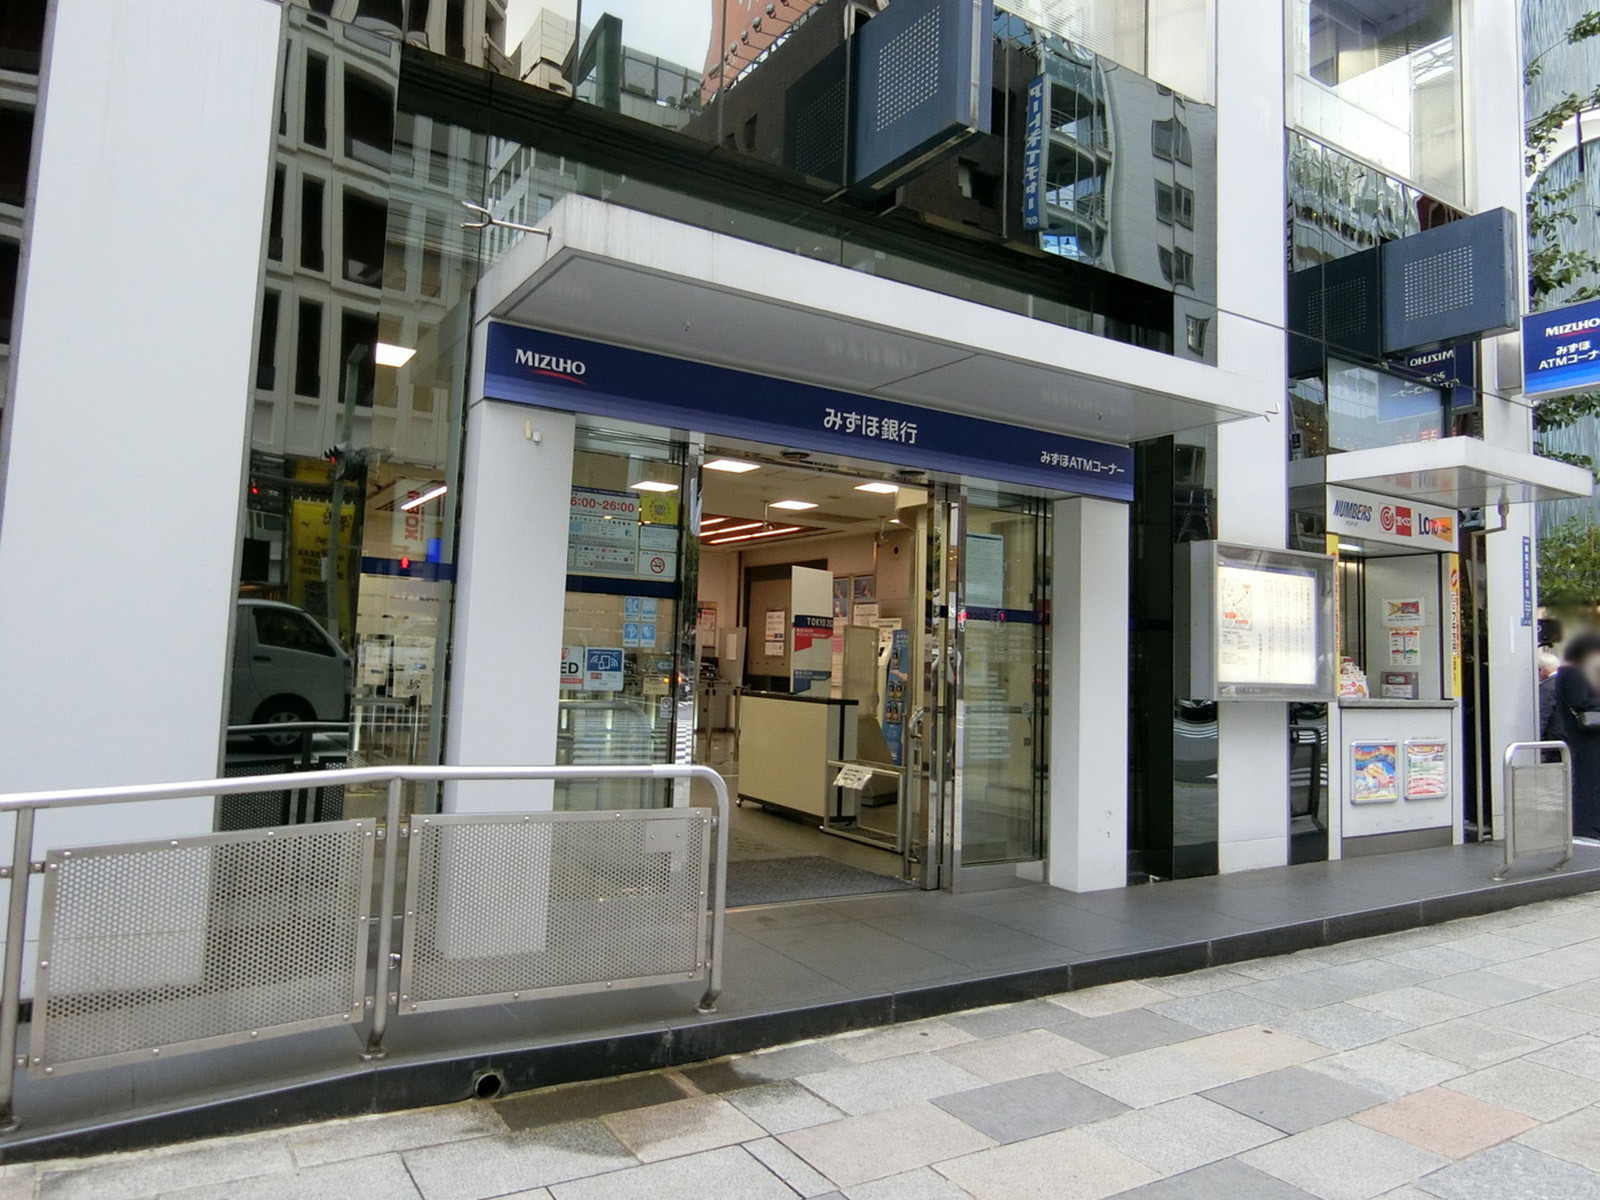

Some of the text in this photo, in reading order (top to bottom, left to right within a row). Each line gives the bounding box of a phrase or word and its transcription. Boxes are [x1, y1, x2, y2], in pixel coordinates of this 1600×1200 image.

[1545, 317, 1600, 338] MIZUHO
[1538, 349, 1600, 371] ATMコーナ
[1556, 341, 1591, 356] みずほ
[515, 349, 586, 376] MIZUHO
[823, 408, 918, 444] みずほ銀行
[1040, 451, 1125, 475] みずほATMコーナー
[1333, 499, 1372, 522] NUMBERS
